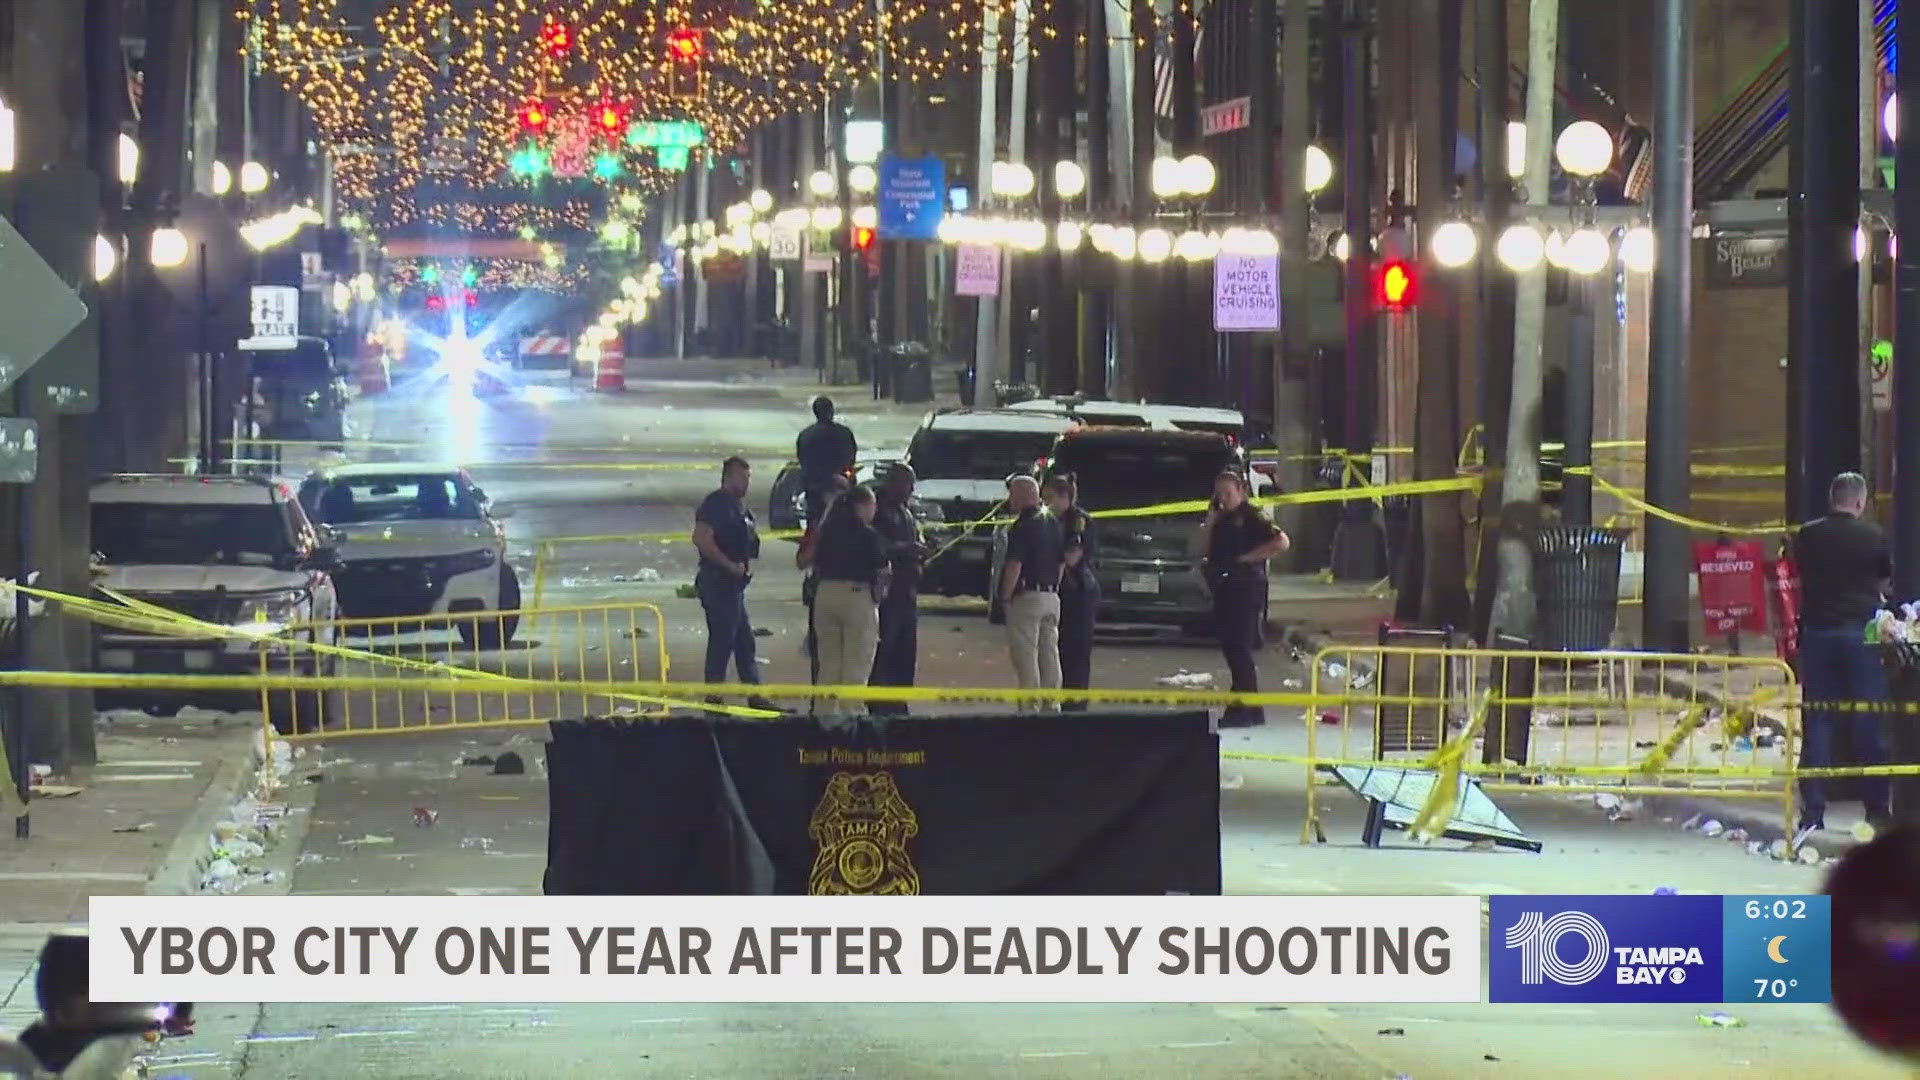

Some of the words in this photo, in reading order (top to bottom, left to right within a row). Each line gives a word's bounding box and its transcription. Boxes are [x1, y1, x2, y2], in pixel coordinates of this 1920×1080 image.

[1240, 257, 1256, 268] NO
[1226, 271, 1268, 282] MOTOR
[1223, 284, 1272, 295] VEHICLE
[1219, 297, 1275, 309] CRUISING
[1701, 561, 1754, 573] RESERVED
[831, 748, 864, 764] Police
[867, 749, 925, 767] Department
[840, 822, 888, 839] TAMPA
